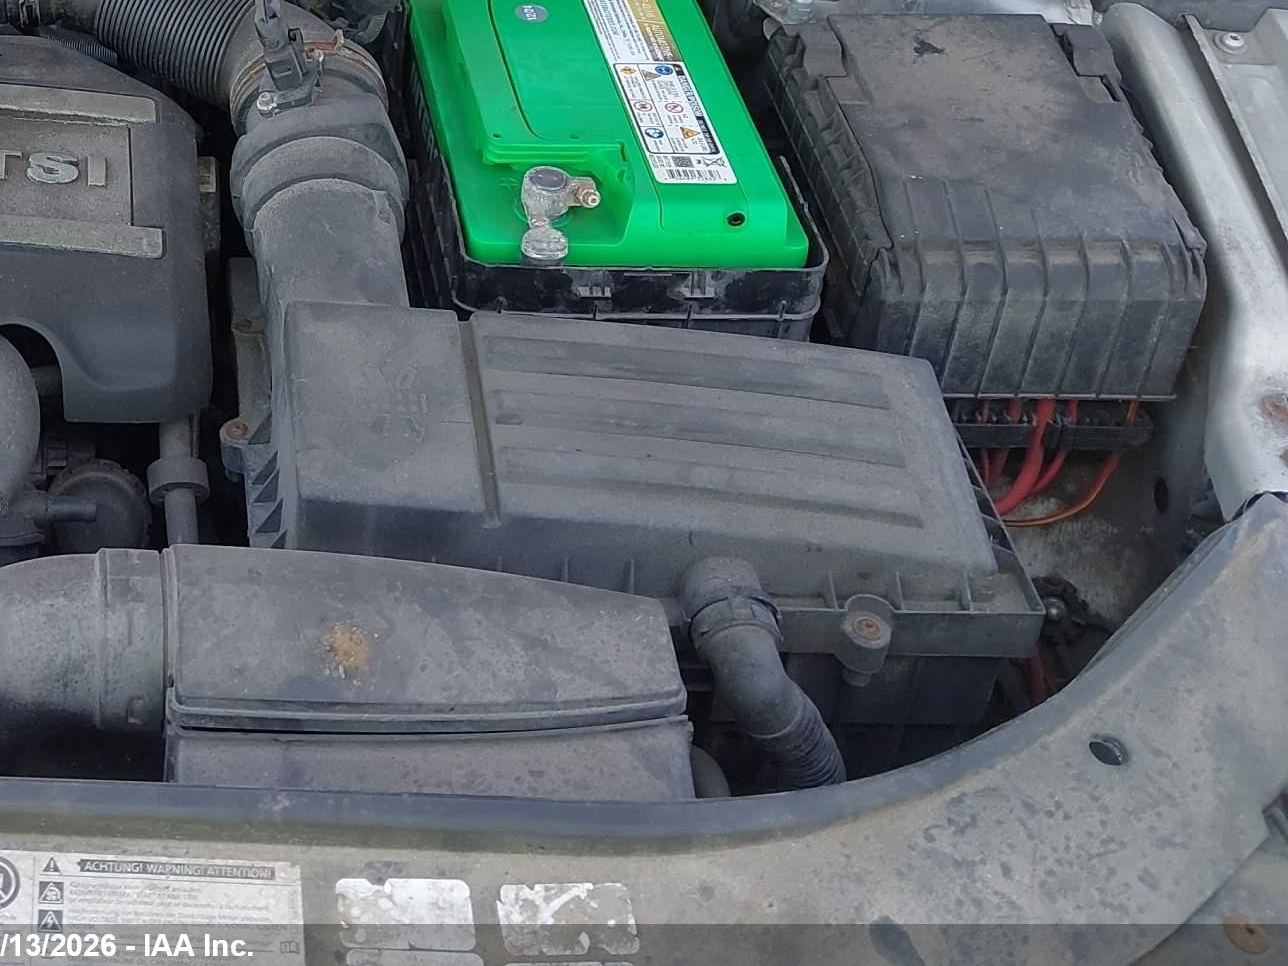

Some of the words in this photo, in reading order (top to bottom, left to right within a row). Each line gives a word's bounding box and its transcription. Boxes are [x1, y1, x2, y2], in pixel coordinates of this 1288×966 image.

[84, 861, 143, 873] ACHTUNG!
[146, 864, 205, 876] WARNING!
[206, 866, 273, 879] ATTENTION!
